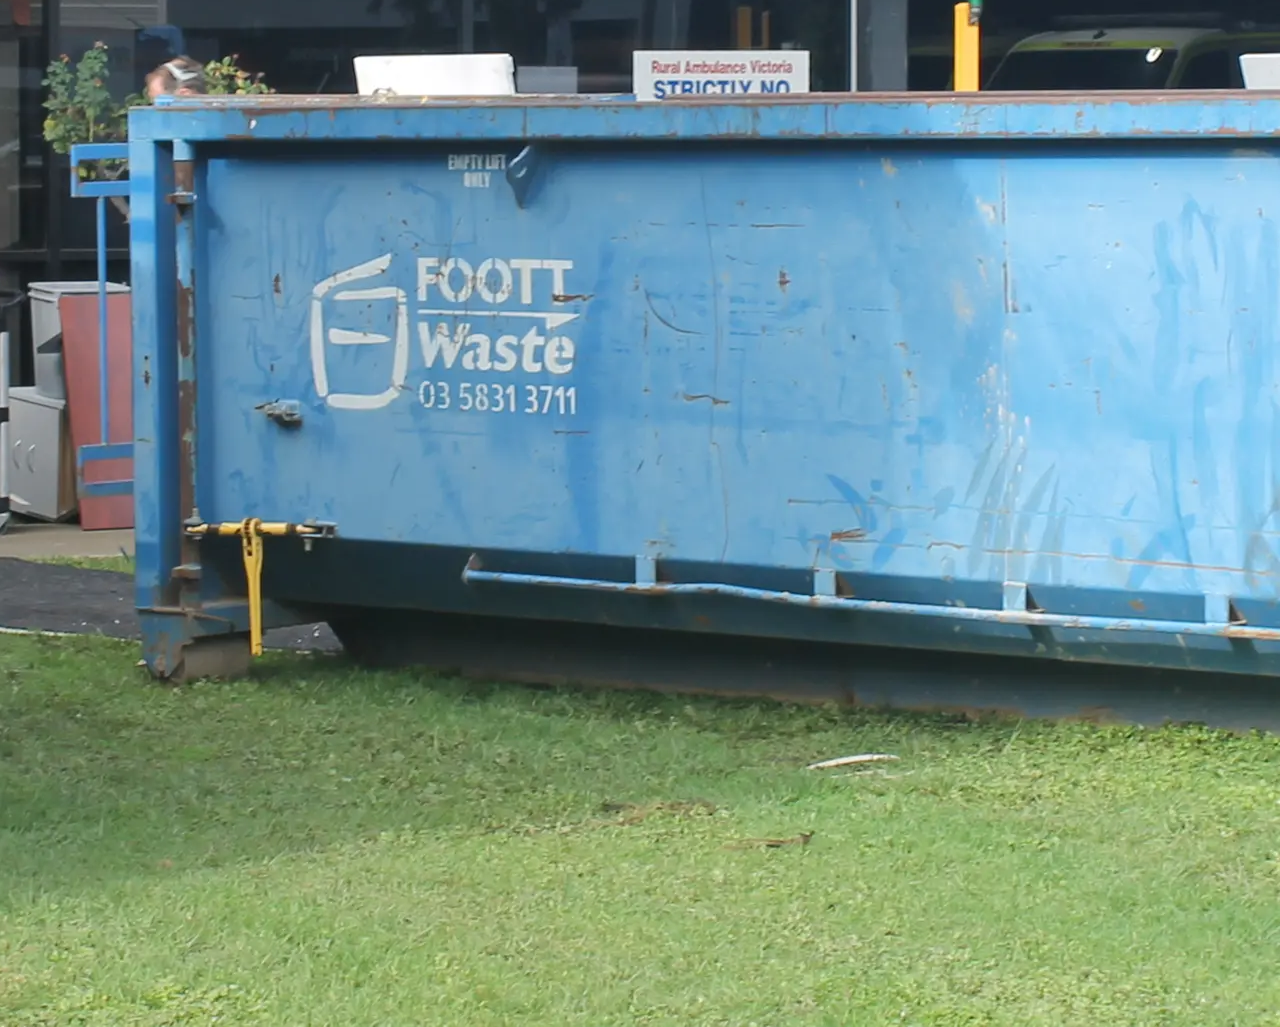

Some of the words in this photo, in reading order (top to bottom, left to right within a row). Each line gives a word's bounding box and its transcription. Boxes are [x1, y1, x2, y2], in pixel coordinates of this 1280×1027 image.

[651, 59, 681, 75] Rural
[684, 59, 747, 75] Ambulance
[750, 59, 793, 75] Victoria
[653, 80, 753, 100] STRICTLY
[448, 153, 484, 171] EMPTY
[485, 153, 507, 171] LIFT
[463, 171, 491, 189] ONLY
[417, 257, 573, 306] FOOTT
[417, 321, 576, 375] Waste
[419, 380, 451, 411] 03
[459, 382, 517, 413] 5831
[524, 384, 577, 415] 3711
